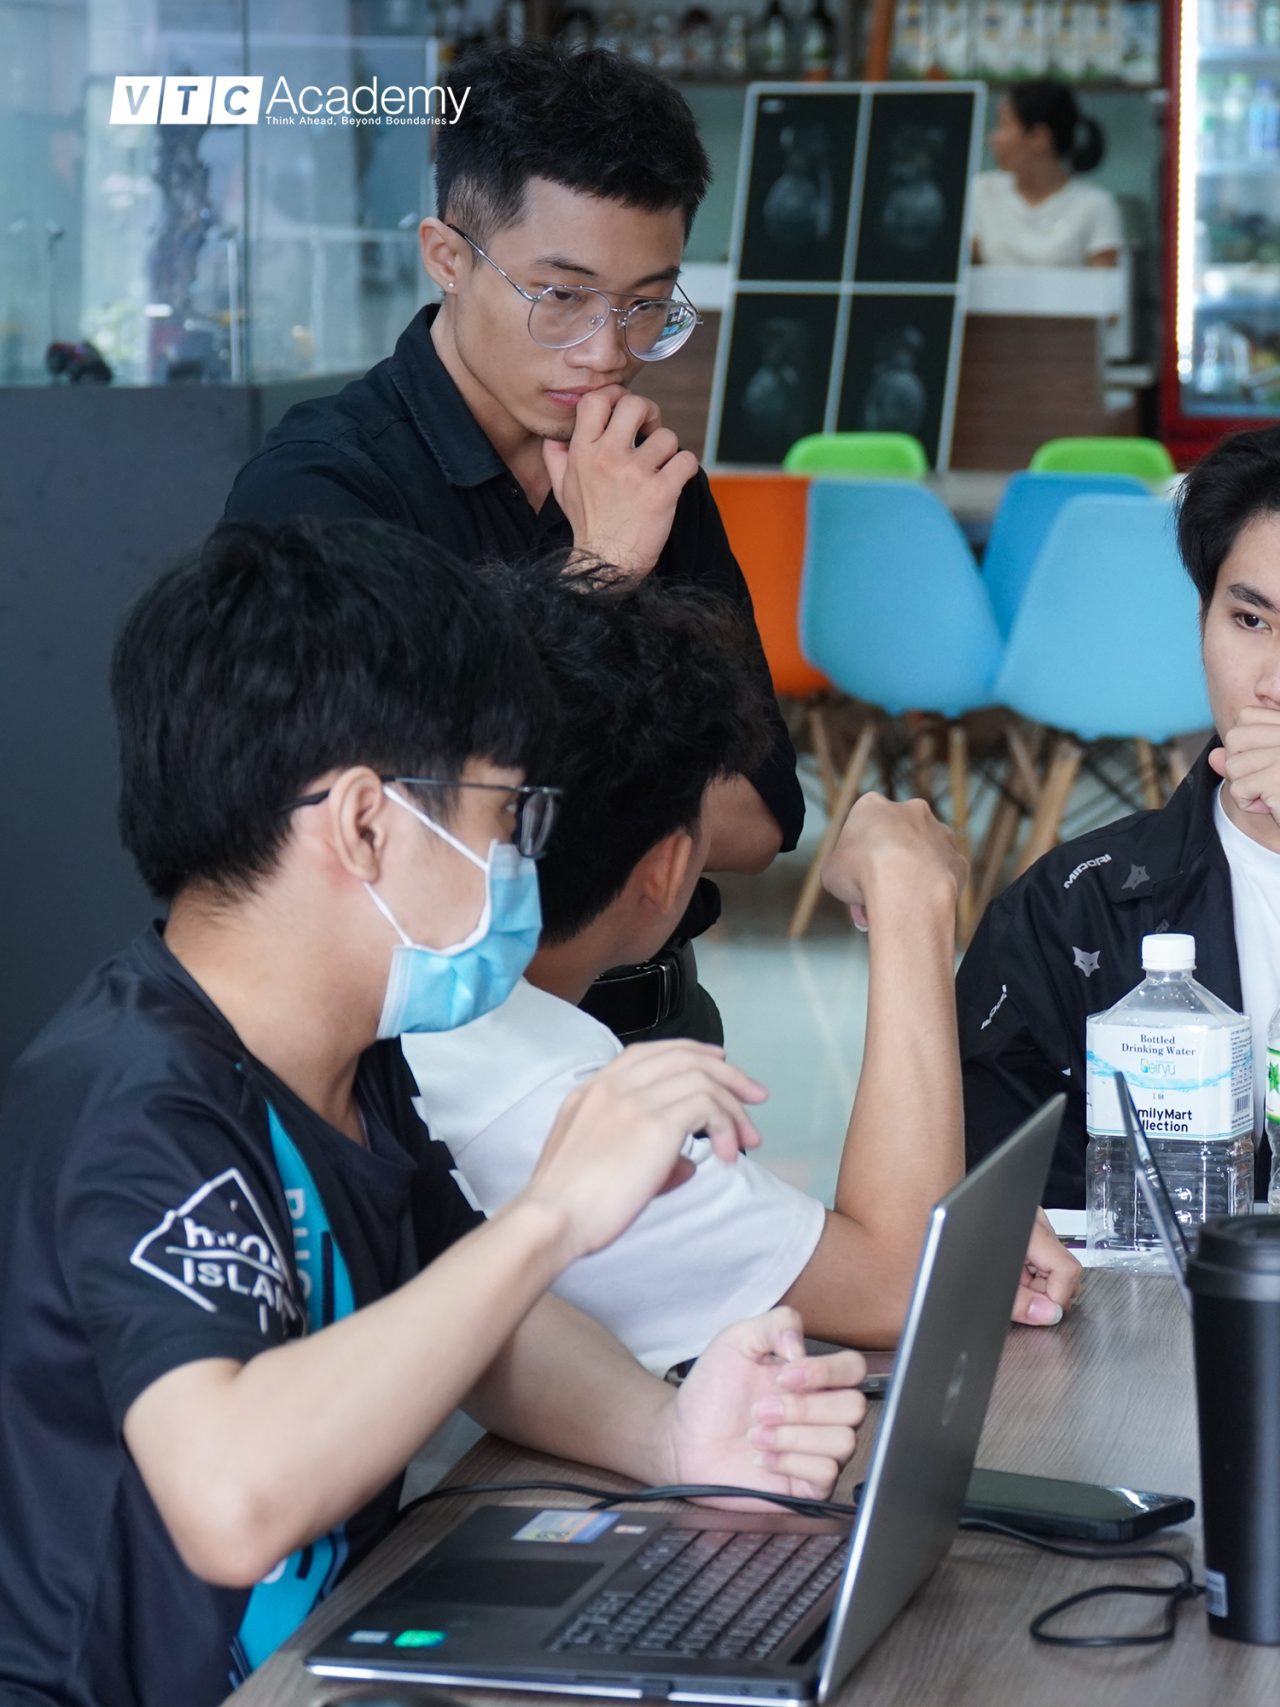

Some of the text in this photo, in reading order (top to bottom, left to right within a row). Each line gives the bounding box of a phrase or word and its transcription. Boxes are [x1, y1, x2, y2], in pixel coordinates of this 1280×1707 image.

[1063, 853, 1112, 889] MIDORI
[1140, 1034, 1175, 1044] Bottled
[1121, 1042, 1197, 1056] Drinking Water
[1137, 1107, 1193, 1121] milyMart
[1142, 1119, 1189, 1133] llection
